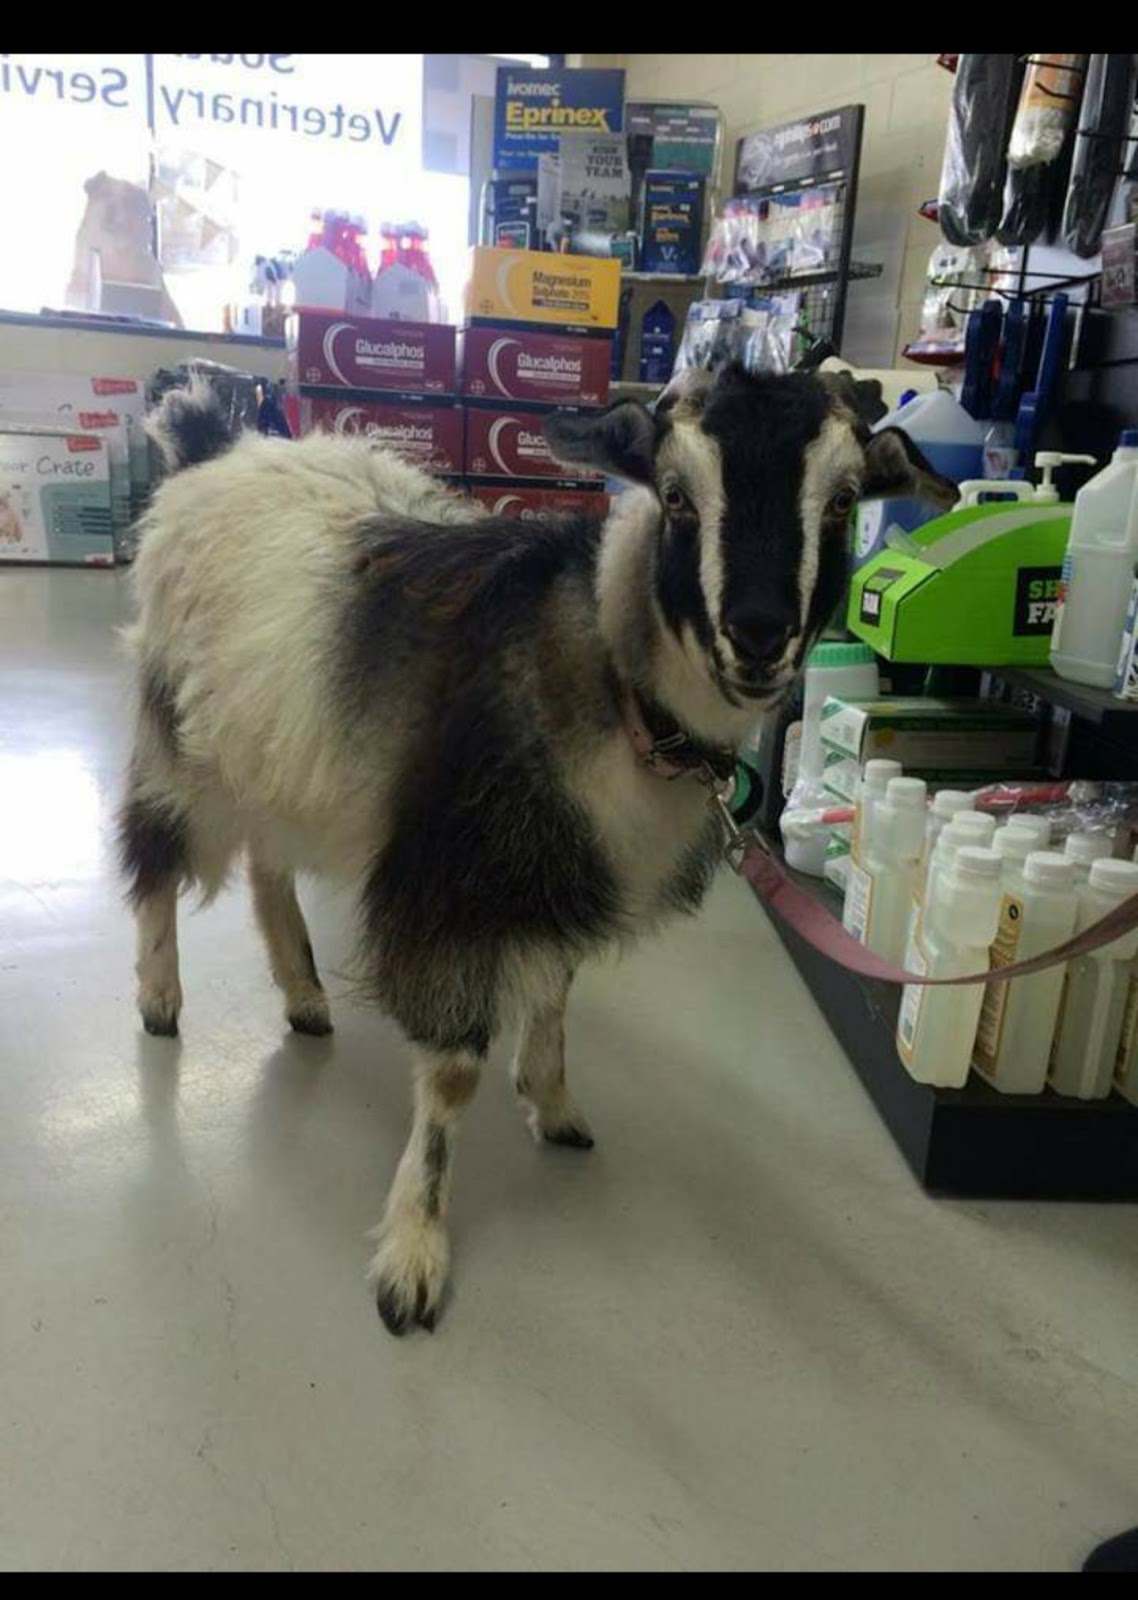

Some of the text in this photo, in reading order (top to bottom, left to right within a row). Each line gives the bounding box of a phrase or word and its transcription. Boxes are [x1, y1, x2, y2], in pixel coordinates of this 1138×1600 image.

[506, 98, 608, 130] Eprinex
[585, 166, 623, 178] TEAM
[533, 271, 592, 287] Magnesium
[355, 338, 424, 360] Glucalphos
[517, 351, 582, 373] Glucalphos
[36, 455, 96, 477] Crate
